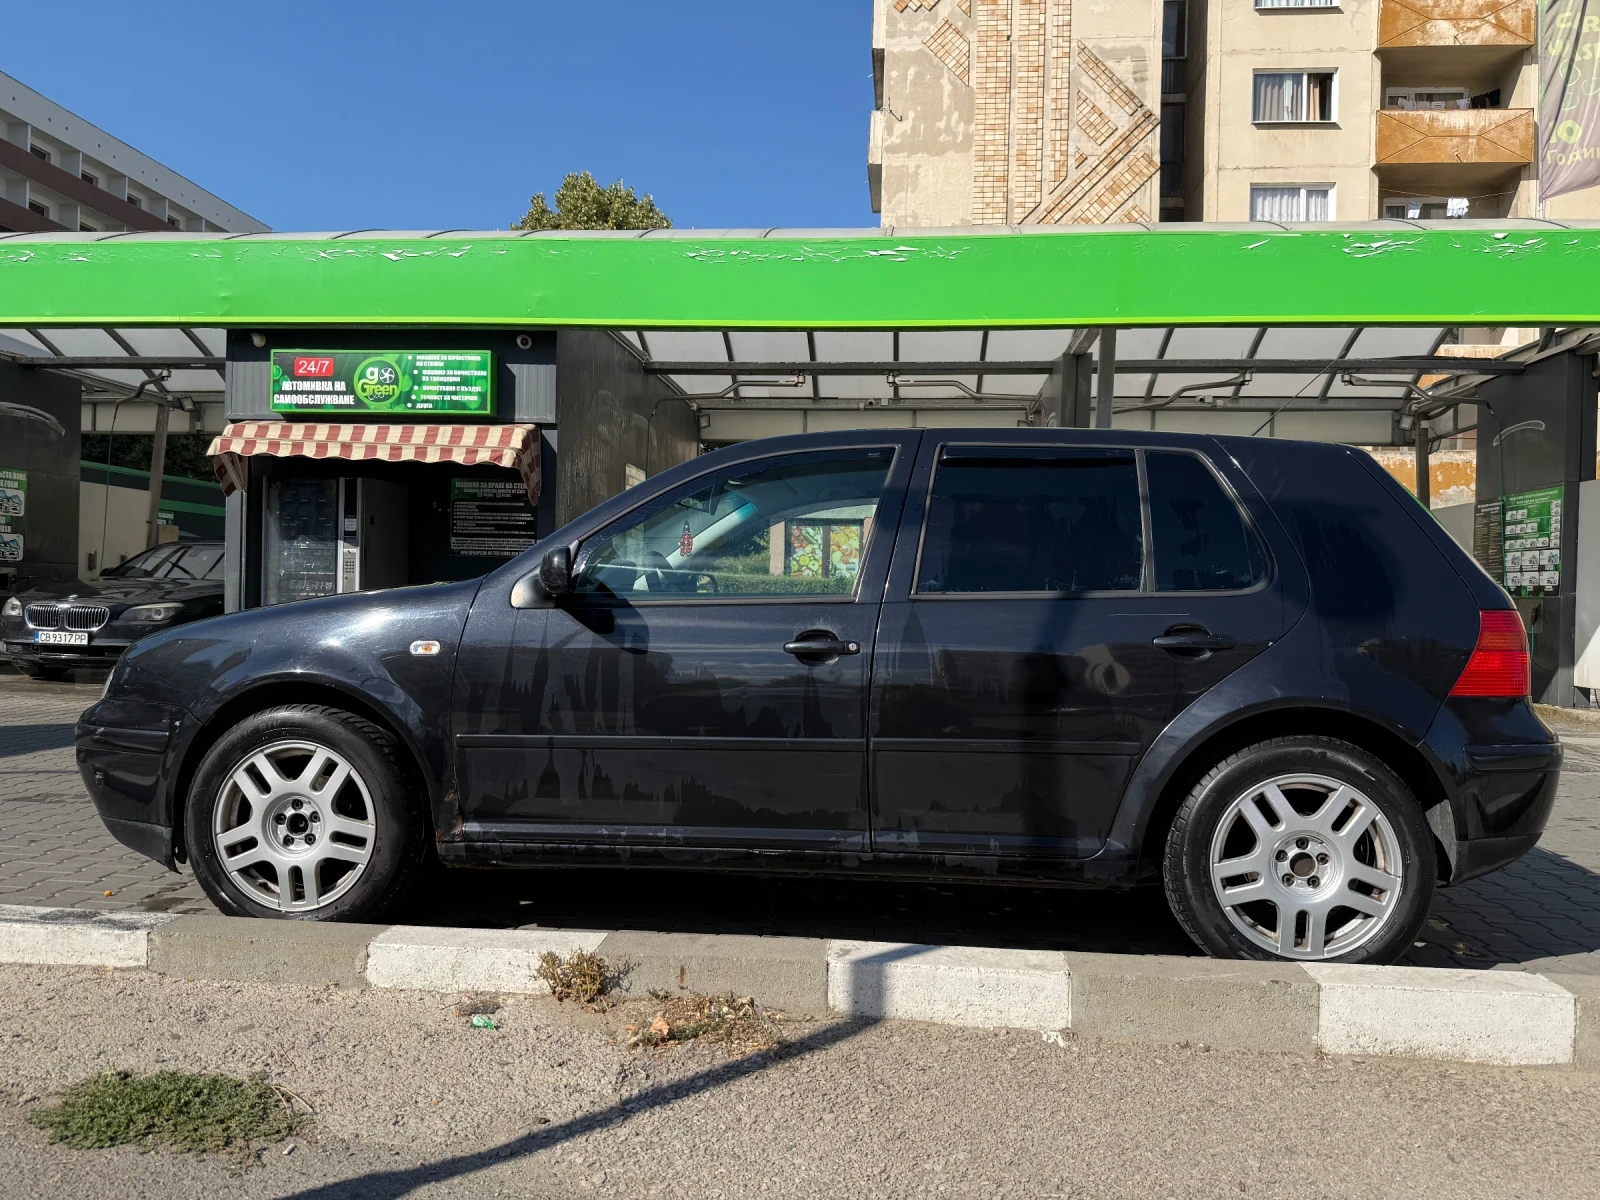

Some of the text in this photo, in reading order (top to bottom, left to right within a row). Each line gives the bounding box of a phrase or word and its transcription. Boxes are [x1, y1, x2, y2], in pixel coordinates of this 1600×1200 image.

[298, 360, 330, 374] 24/7
[281, 381, 346, 391] АВТОМИВКА НА
[273, 394, 355, 405] САМООБСЛУЖВАНЕ
[52, 633, 73, 643] 9317
[74, 634, 86, 643] PP
